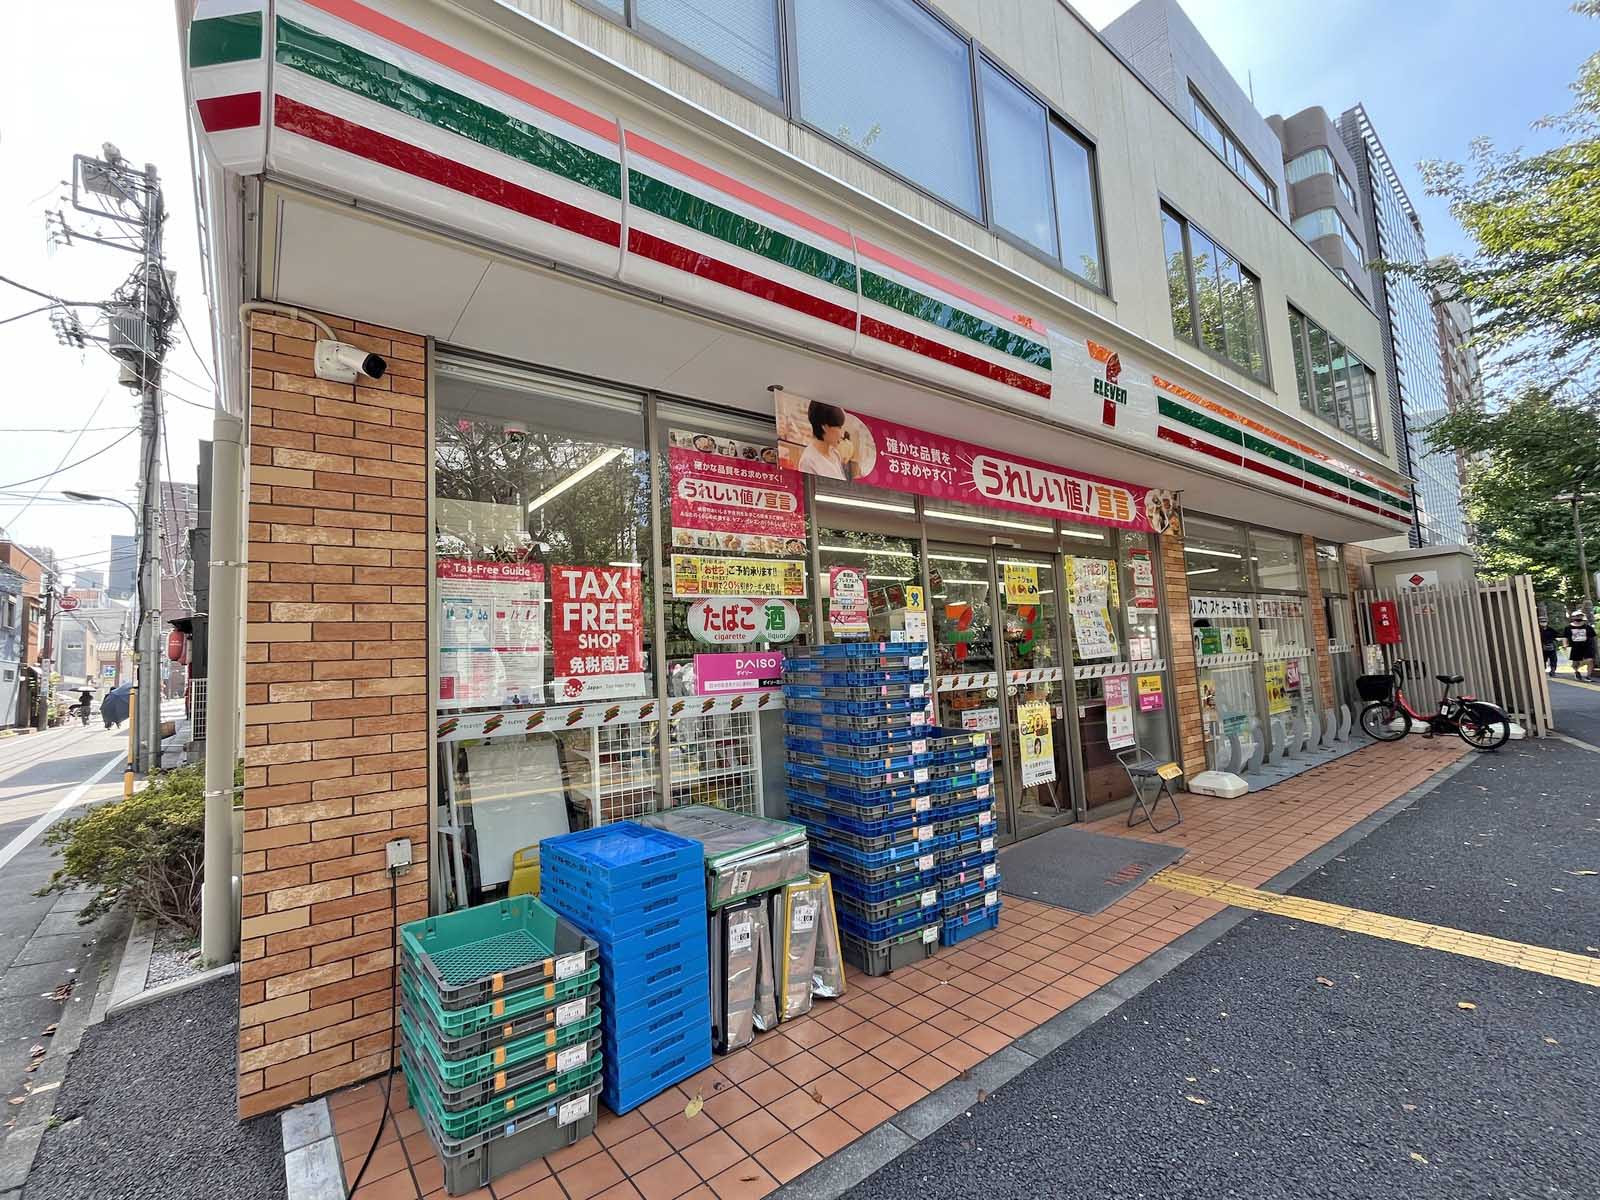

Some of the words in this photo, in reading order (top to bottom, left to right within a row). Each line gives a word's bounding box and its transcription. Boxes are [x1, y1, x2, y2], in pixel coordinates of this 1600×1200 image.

[886, 437, 951, 465] 確かな品質を
[889, 459, 952, 485] お求めやすく!
[684, 480, 791, 511] うれしい値!宣言
[982, 459, 1130, 520] うれしい値!宣言
[453, 563, 499, 575] Tax-Free
[504, 565, 530, 576] Guide
[562, 570, 631, 599] TAX-
[563, 603, 634, 631] FREE
[703, 604, 756, 632] たばこ
[765, 605, 786, 631] 酒
[579, 633, 621, 649] SHOP
[714, 633, 747, 641] cigarette
[767, 632, 787, 640] liquor
[570, 656, 630, 674] 免税商店
[735, 658, 776, 669] DAISO
